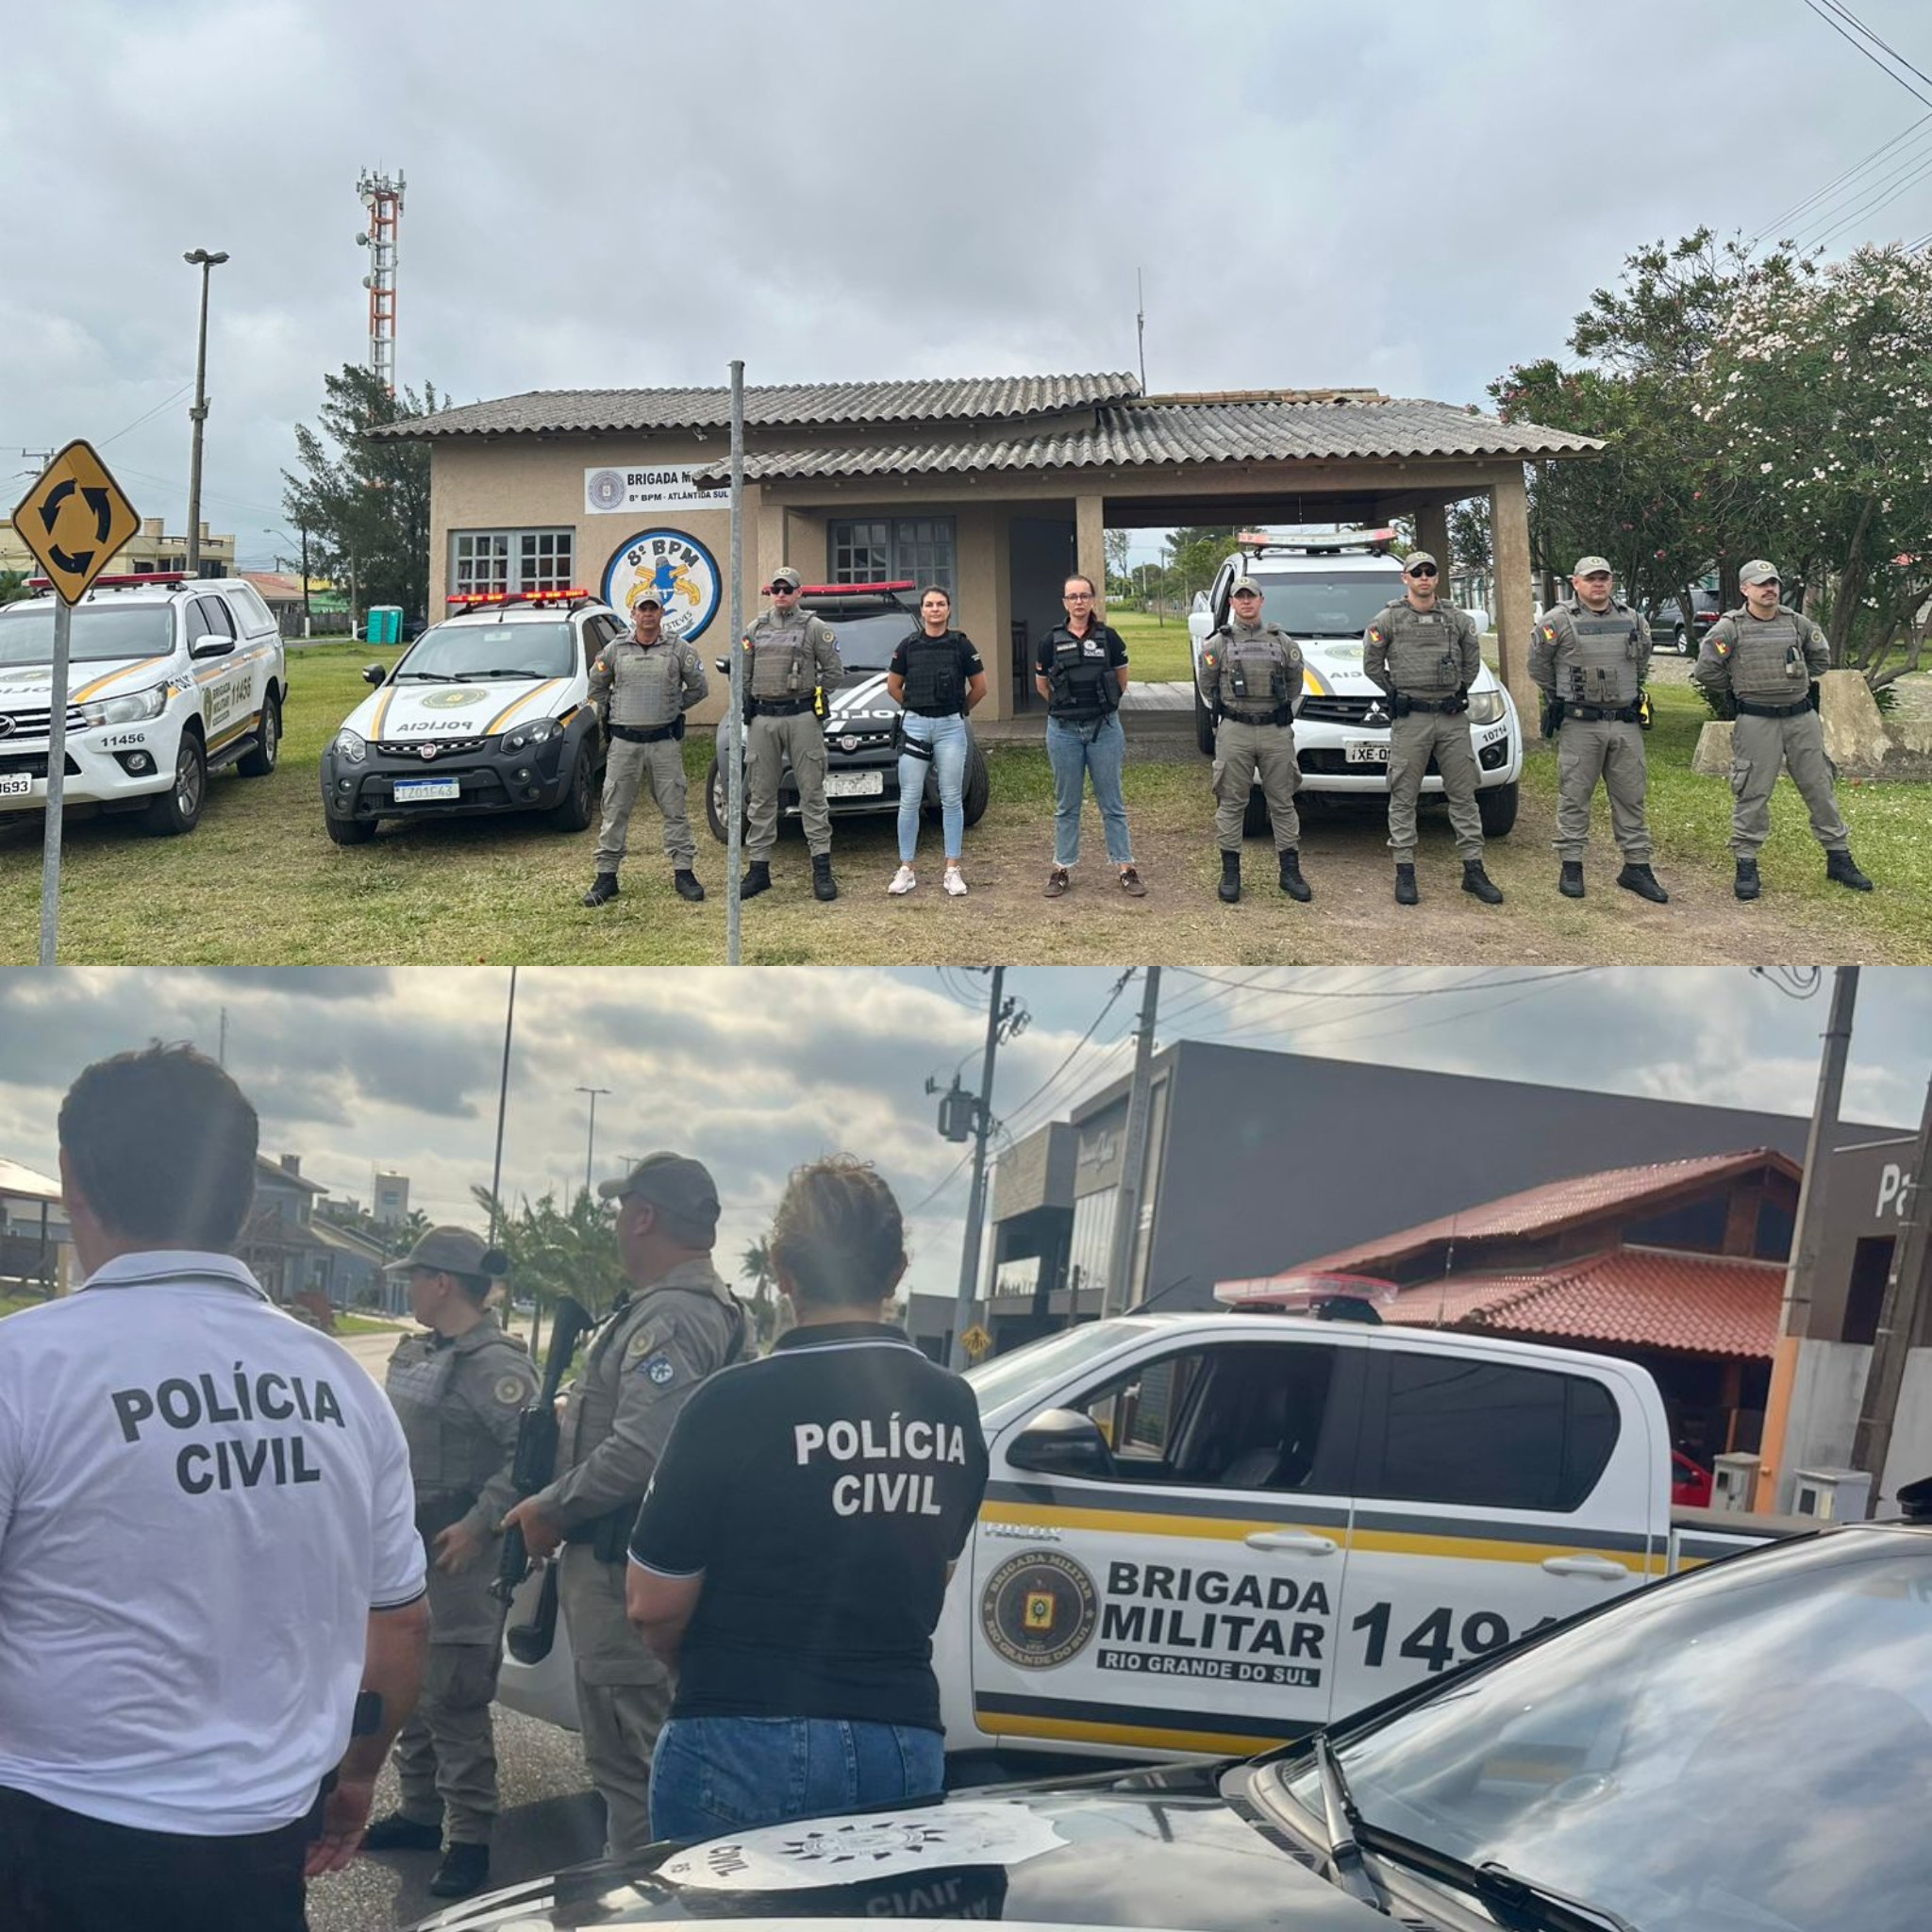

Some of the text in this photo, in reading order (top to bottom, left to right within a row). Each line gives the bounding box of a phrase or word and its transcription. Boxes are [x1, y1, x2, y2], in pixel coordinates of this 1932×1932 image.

[627, 473, 678, 486] BRIGADA
[641, 493, 661, 502] BPM
[713, 490, 729, 498] SUL
[652, 539, 699, 568] BPM
[101, 733, 145, 746] 11456
[0, 780, 28, 793] 693
[111, 1361, 345, 1442] POLÍCIA
[794, 1411, 965, 1466] POLÍCIA
[176, 1437, 321, 1494] CIVIL
[832, 1473, 941, 1516] CIVIL
[991, 1554, 1092, 1599] BRIGADA MILITAR
[1108, 1561, 1330, 1615] BRIGADA
[986, 1619, 1091, 1665] RIO GRANDE DO SUL
[1101, 1603, 1323, 1659] MILITAR
[1352, 1601, 1557, 1672] 149
[1105, 1653, 1312, 1686] RIO GRANDE DO SUL
